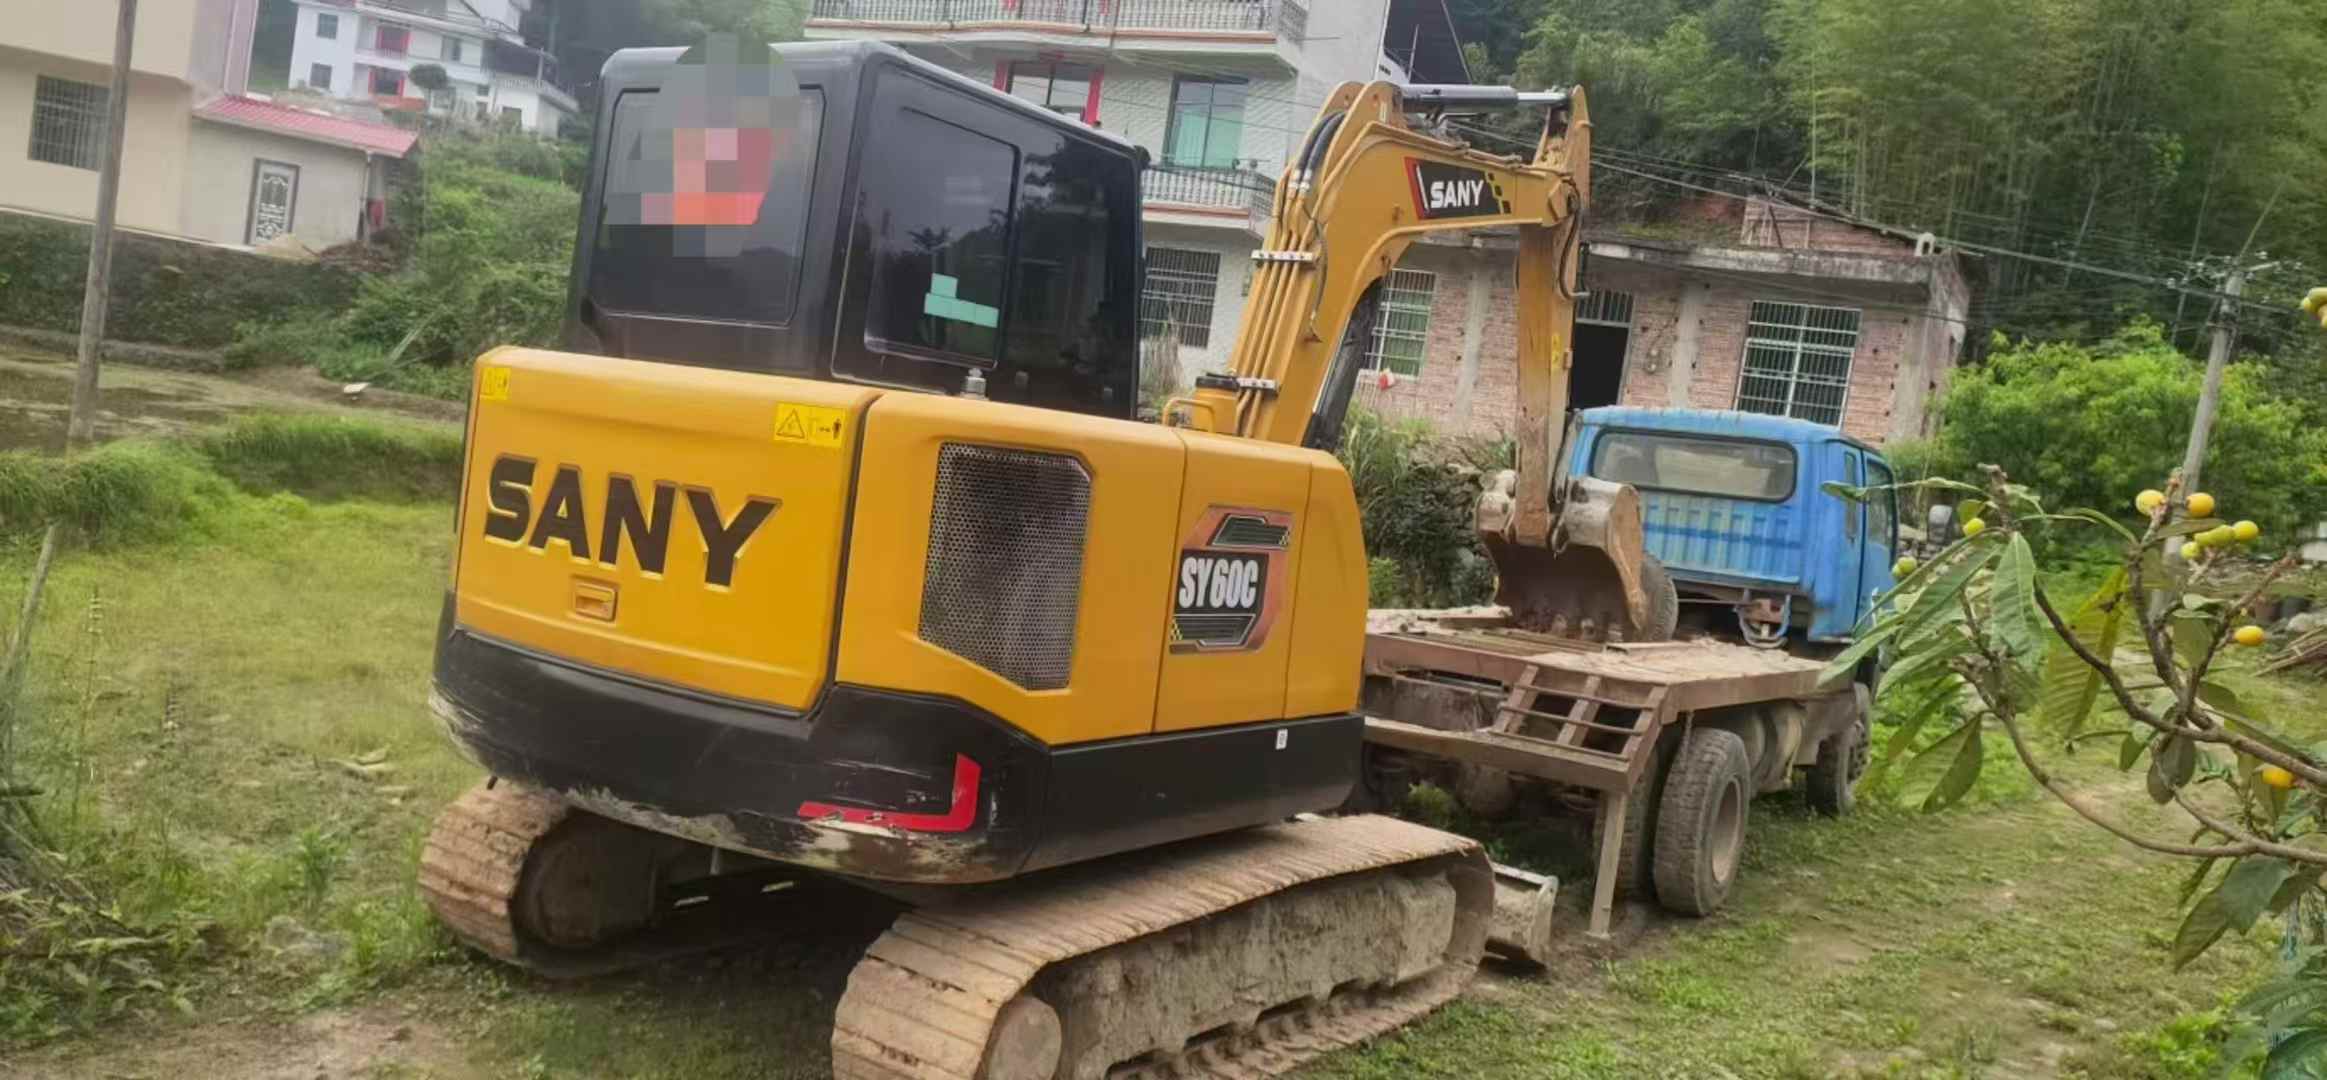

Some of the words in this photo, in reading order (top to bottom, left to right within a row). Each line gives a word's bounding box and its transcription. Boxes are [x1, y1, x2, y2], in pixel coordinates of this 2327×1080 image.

[1430, 180, 1484, 208] SANY
[485, 454, 781, 591] SANY
[1178, 556, 1260, 609] SY60C
